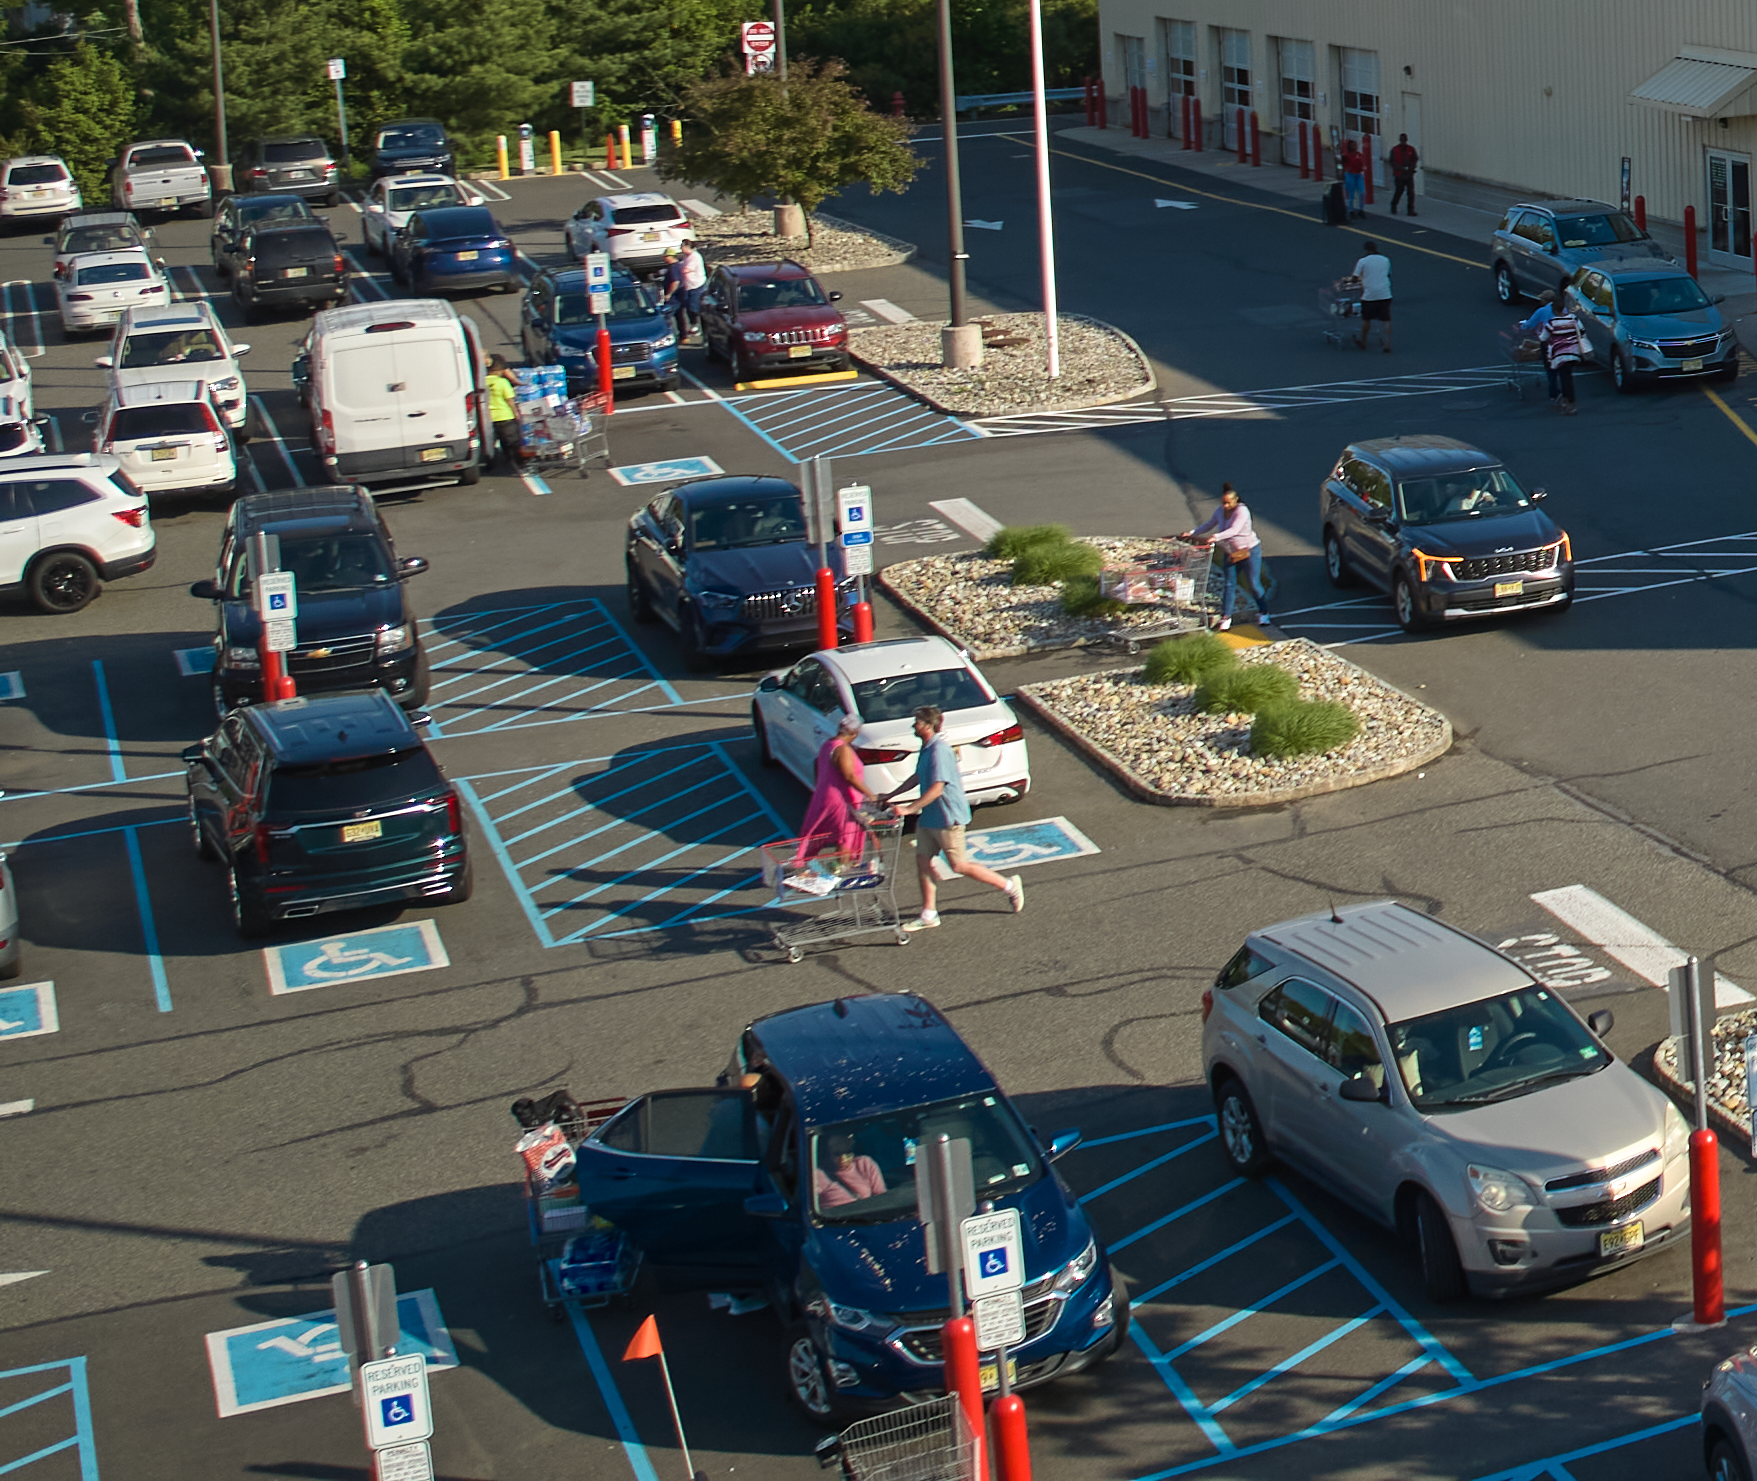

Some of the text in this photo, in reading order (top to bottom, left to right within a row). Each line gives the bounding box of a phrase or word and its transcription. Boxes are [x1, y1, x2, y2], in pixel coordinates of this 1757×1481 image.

[966, 1216, 1016, 1236] RESERVED
[970, 1230, 1014, 1250] PARKING
[367, 1362, 421, 1382] RESERVED
[372, 1377, 419, 1396] PARKING
